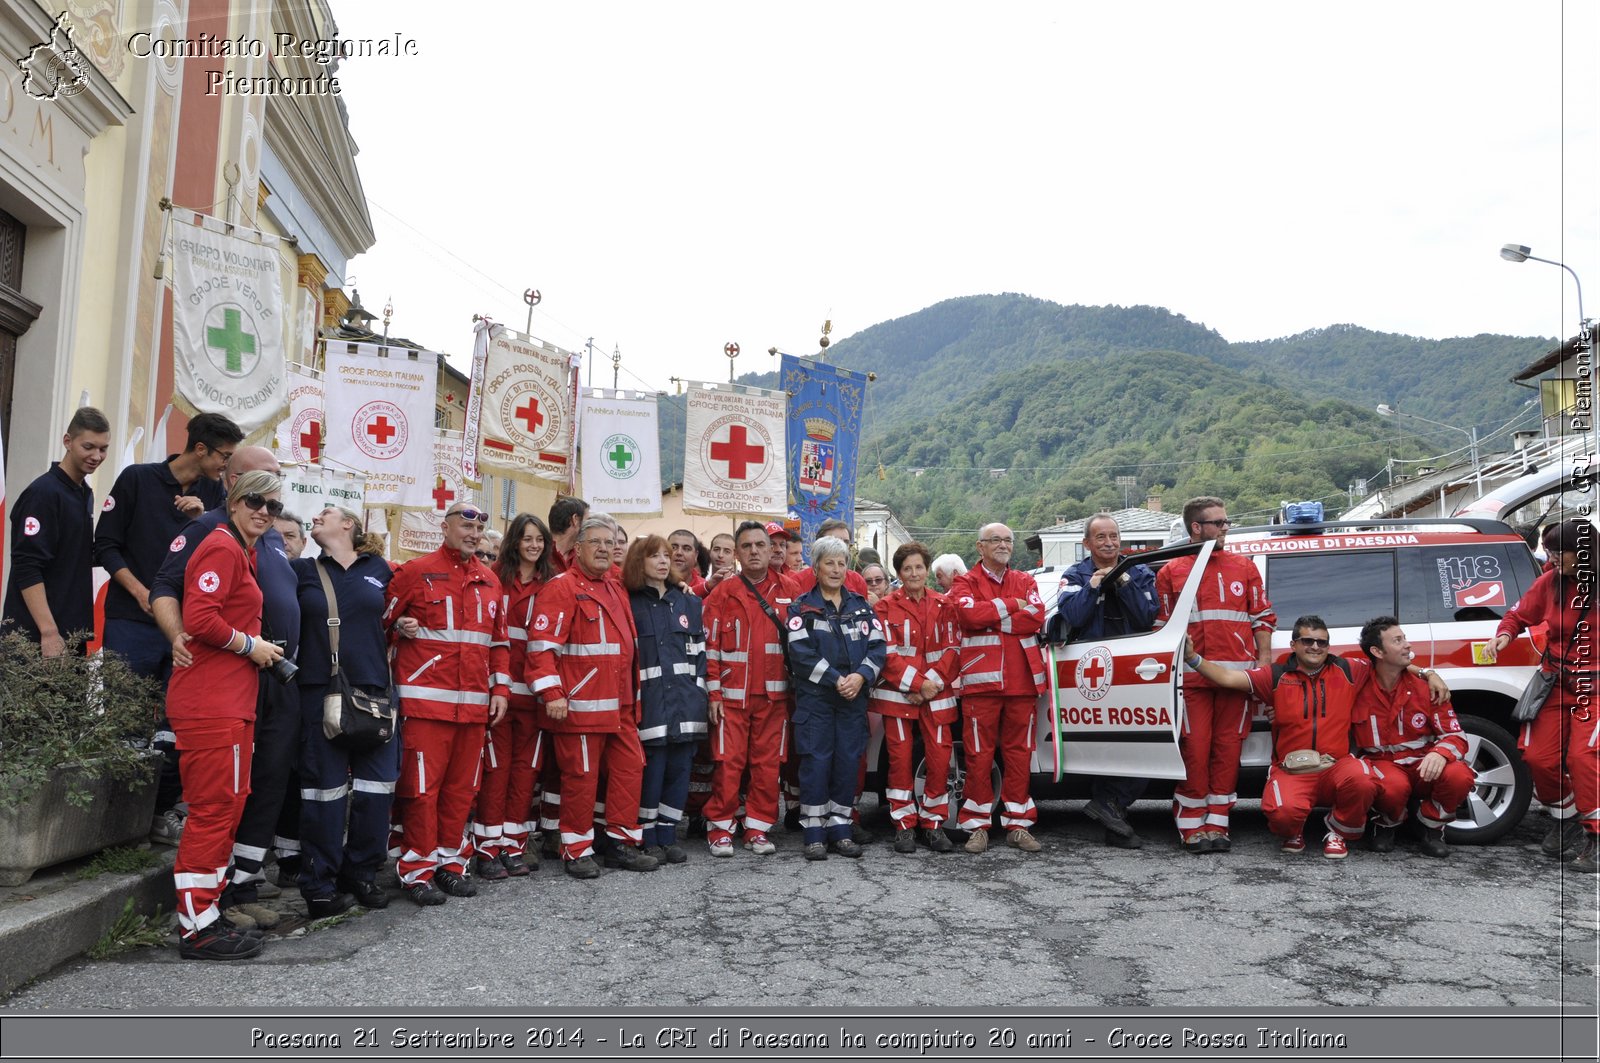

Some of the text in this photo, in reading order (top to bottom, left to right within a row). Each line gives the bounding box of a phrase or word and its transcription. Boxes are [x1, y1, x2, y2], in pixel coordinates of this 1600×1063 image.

[189, 276, 273, 321] CROCE VERDE
[338, 365, 365, 376] CROCE
[367, 369, 393, 379] ROSSA
[488, 368, 512, 395] CROCE
[513, 363, 542, 379] ROSSA
[513, 385, 522, 394] DI
[548, 403, 557, 412] 22
[689, 400, 719, 411] CROCE
[721, 404, 749, 414] ROSSA
[502, 392, 525, 444] CONVENZIONE
[465, 425, 477, 457] CROCE
[604, 436, 637, 450] CROCE VERDE
[482, 448, 526, 464] COMITATO
[609, 469, 632, 477] CAVOUR
[364, 482, 398, 492] BARGE
[407, 476, 416, 485] DI
[700, 490, 772, 504] DELEGAZIONE DI
[708, 500, 763, 512] DRONERO
[402, 529, 436, 540] GRUPPO
[1324, 538, 1341, 549] DI
[1345, 534, 1419, 547] PAESANA
[402, 538, 439, 551] COMITATO
[1444, 555, 1501, 580] 118
[1436, 558, 1453, 609] PIEMONTE
[1108, 707, 1173, 726] ROSSA
